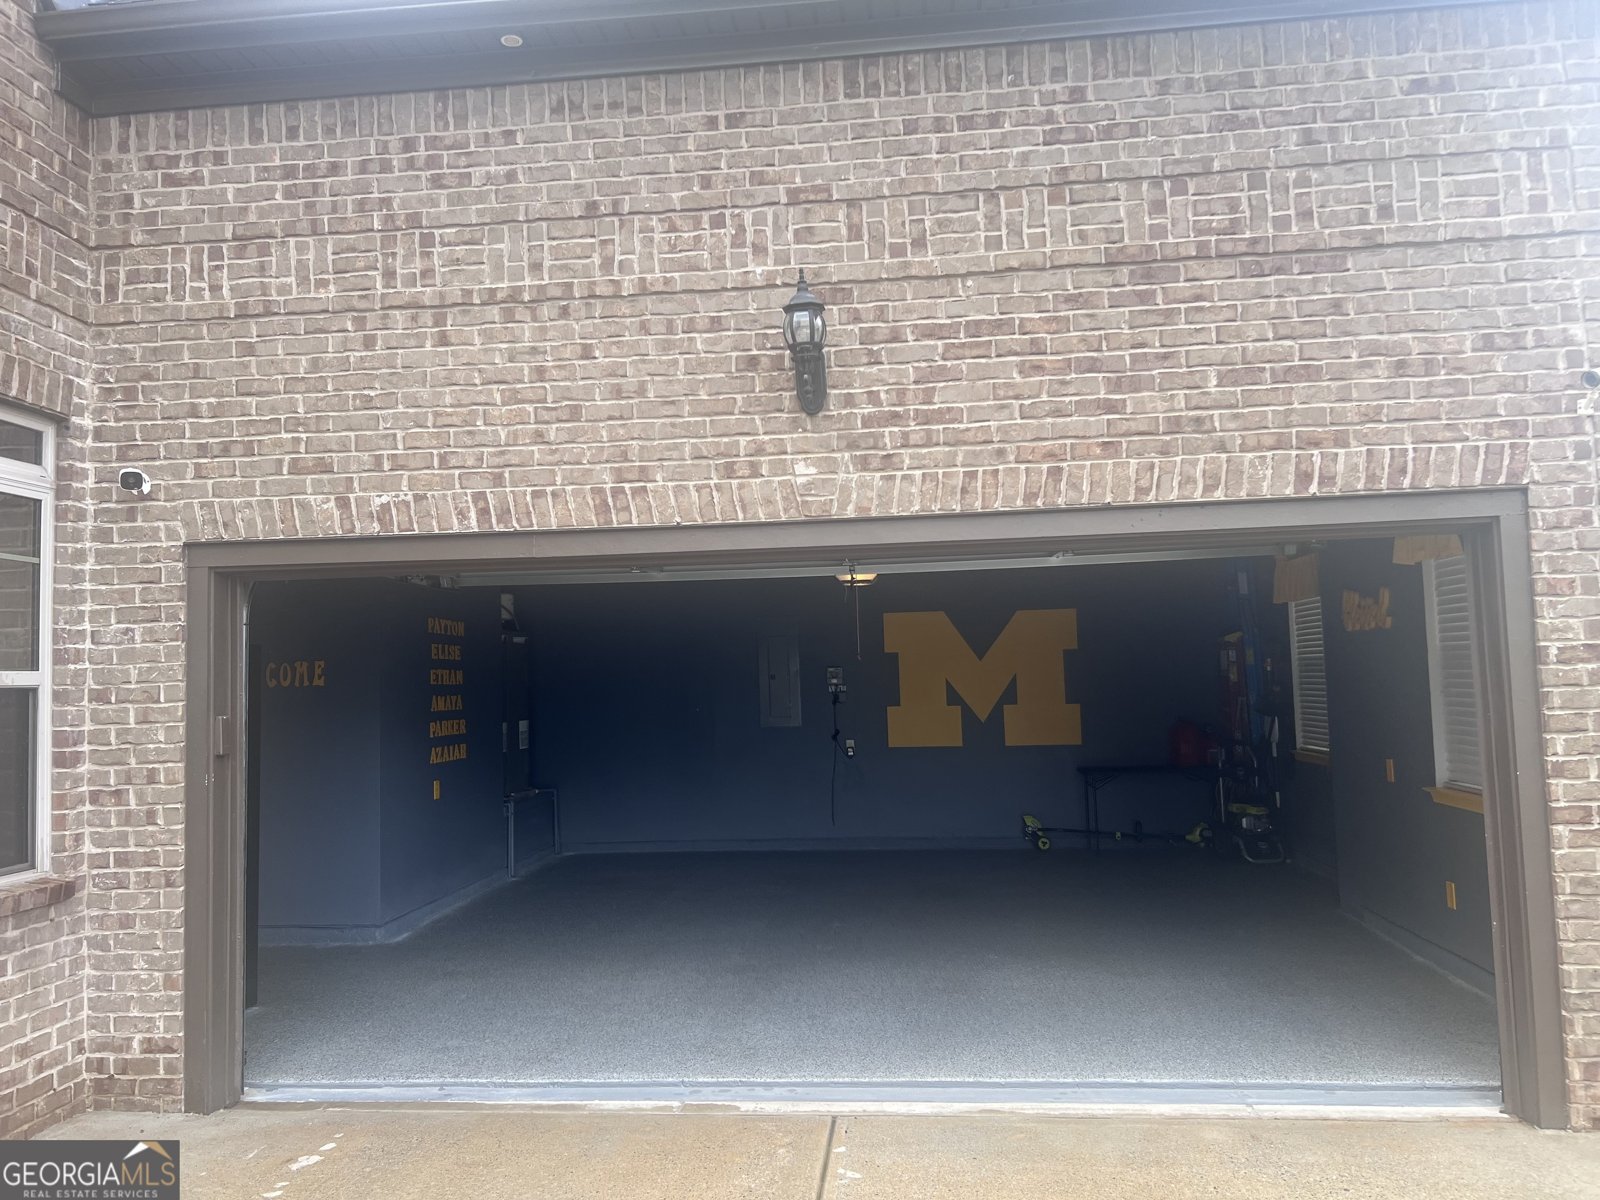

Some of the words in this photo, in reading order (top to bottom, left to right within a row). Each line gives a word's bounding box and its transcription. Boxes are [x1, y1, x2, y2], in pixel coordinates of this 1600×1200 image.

[428, 617, 465, 637] PAYTON
[431, 643, 462, 661] ELISE
[265, 660, 326, 688] COME
[430, 669, 463, 686] ETHAN
[882, 608, 1083, 748] M
[431, 695, 463, 712] AMAYA
[429, 719, 466, 738] PARKER
[430, 744, 466, 765] AZAIAH
